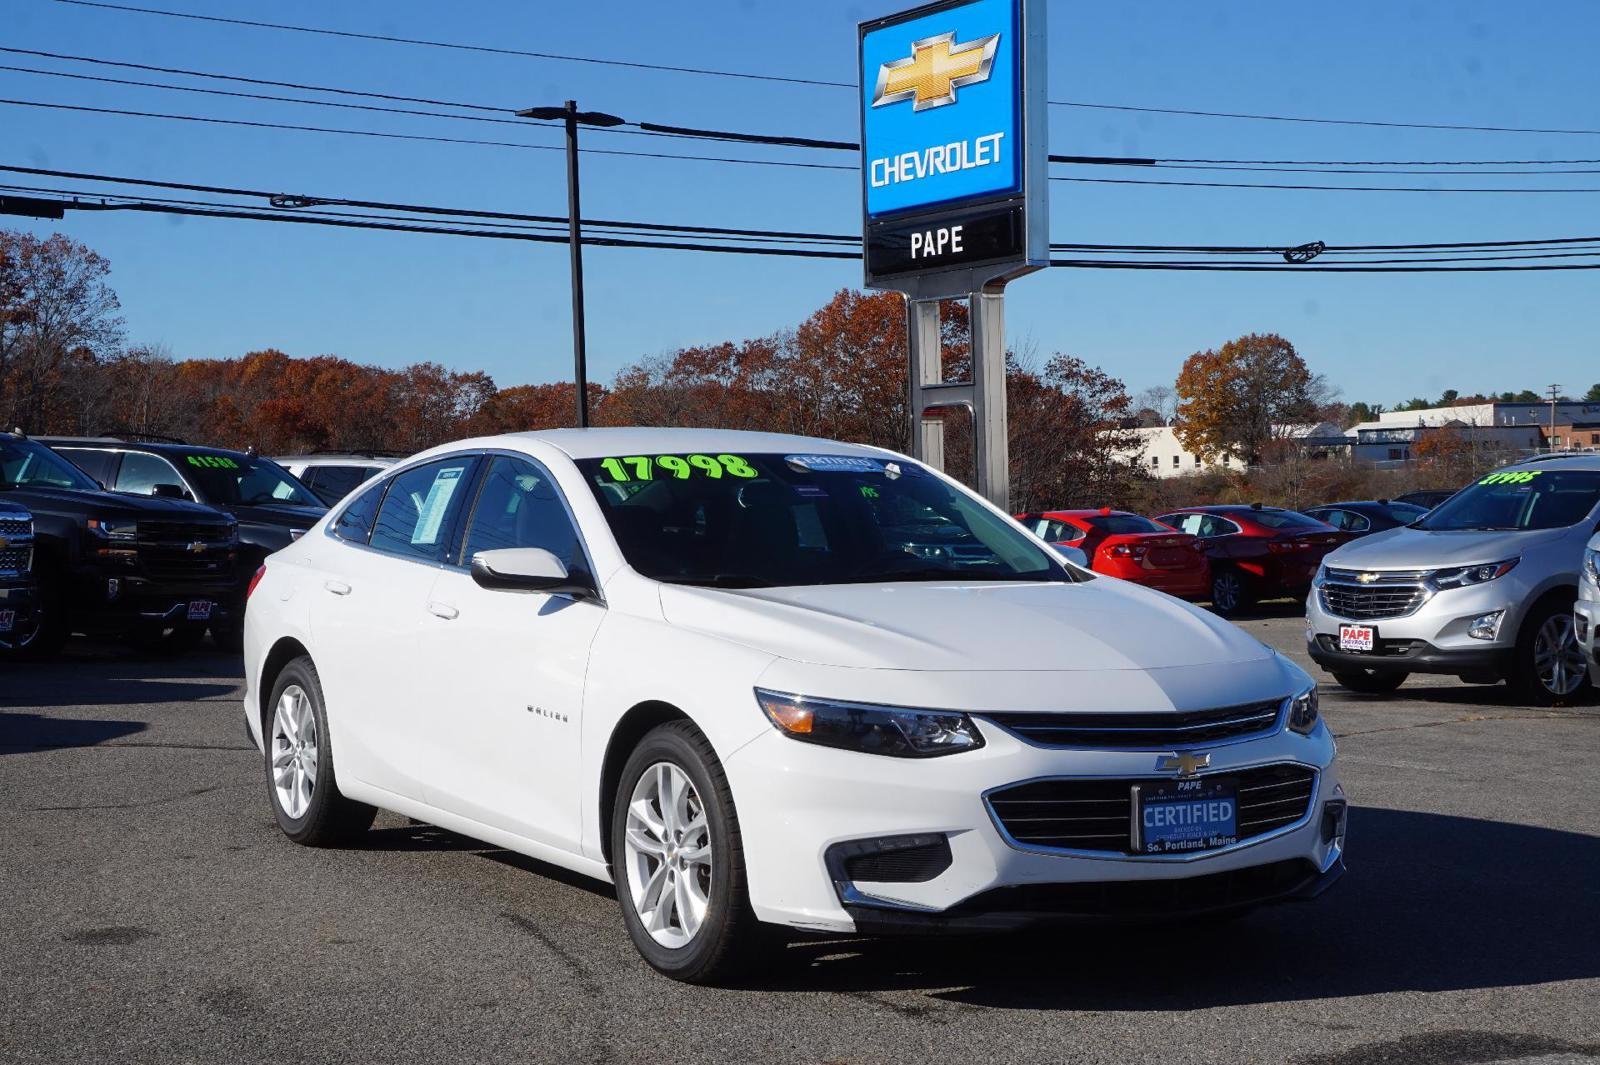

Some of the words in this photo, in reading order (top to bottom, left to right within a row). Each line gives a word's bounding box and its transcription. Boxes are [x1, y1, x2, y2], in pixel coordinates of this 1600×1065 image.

[871, 132, 1004, 187] CHEVROLET
[911, 226, 963, 259] PAPE
[601, 454, 758, 482] 17998
[1343, 629, 1369, 640] PAPE
[1178, 781, 1203, 790] PAPE
[1144, 802, 1233, 827] CERTIFIED
[1147, 843, 1162, 852] So.
[1166, 838, 1206, 851] Portland,
[1210, 836, 1237, 846] Maine
